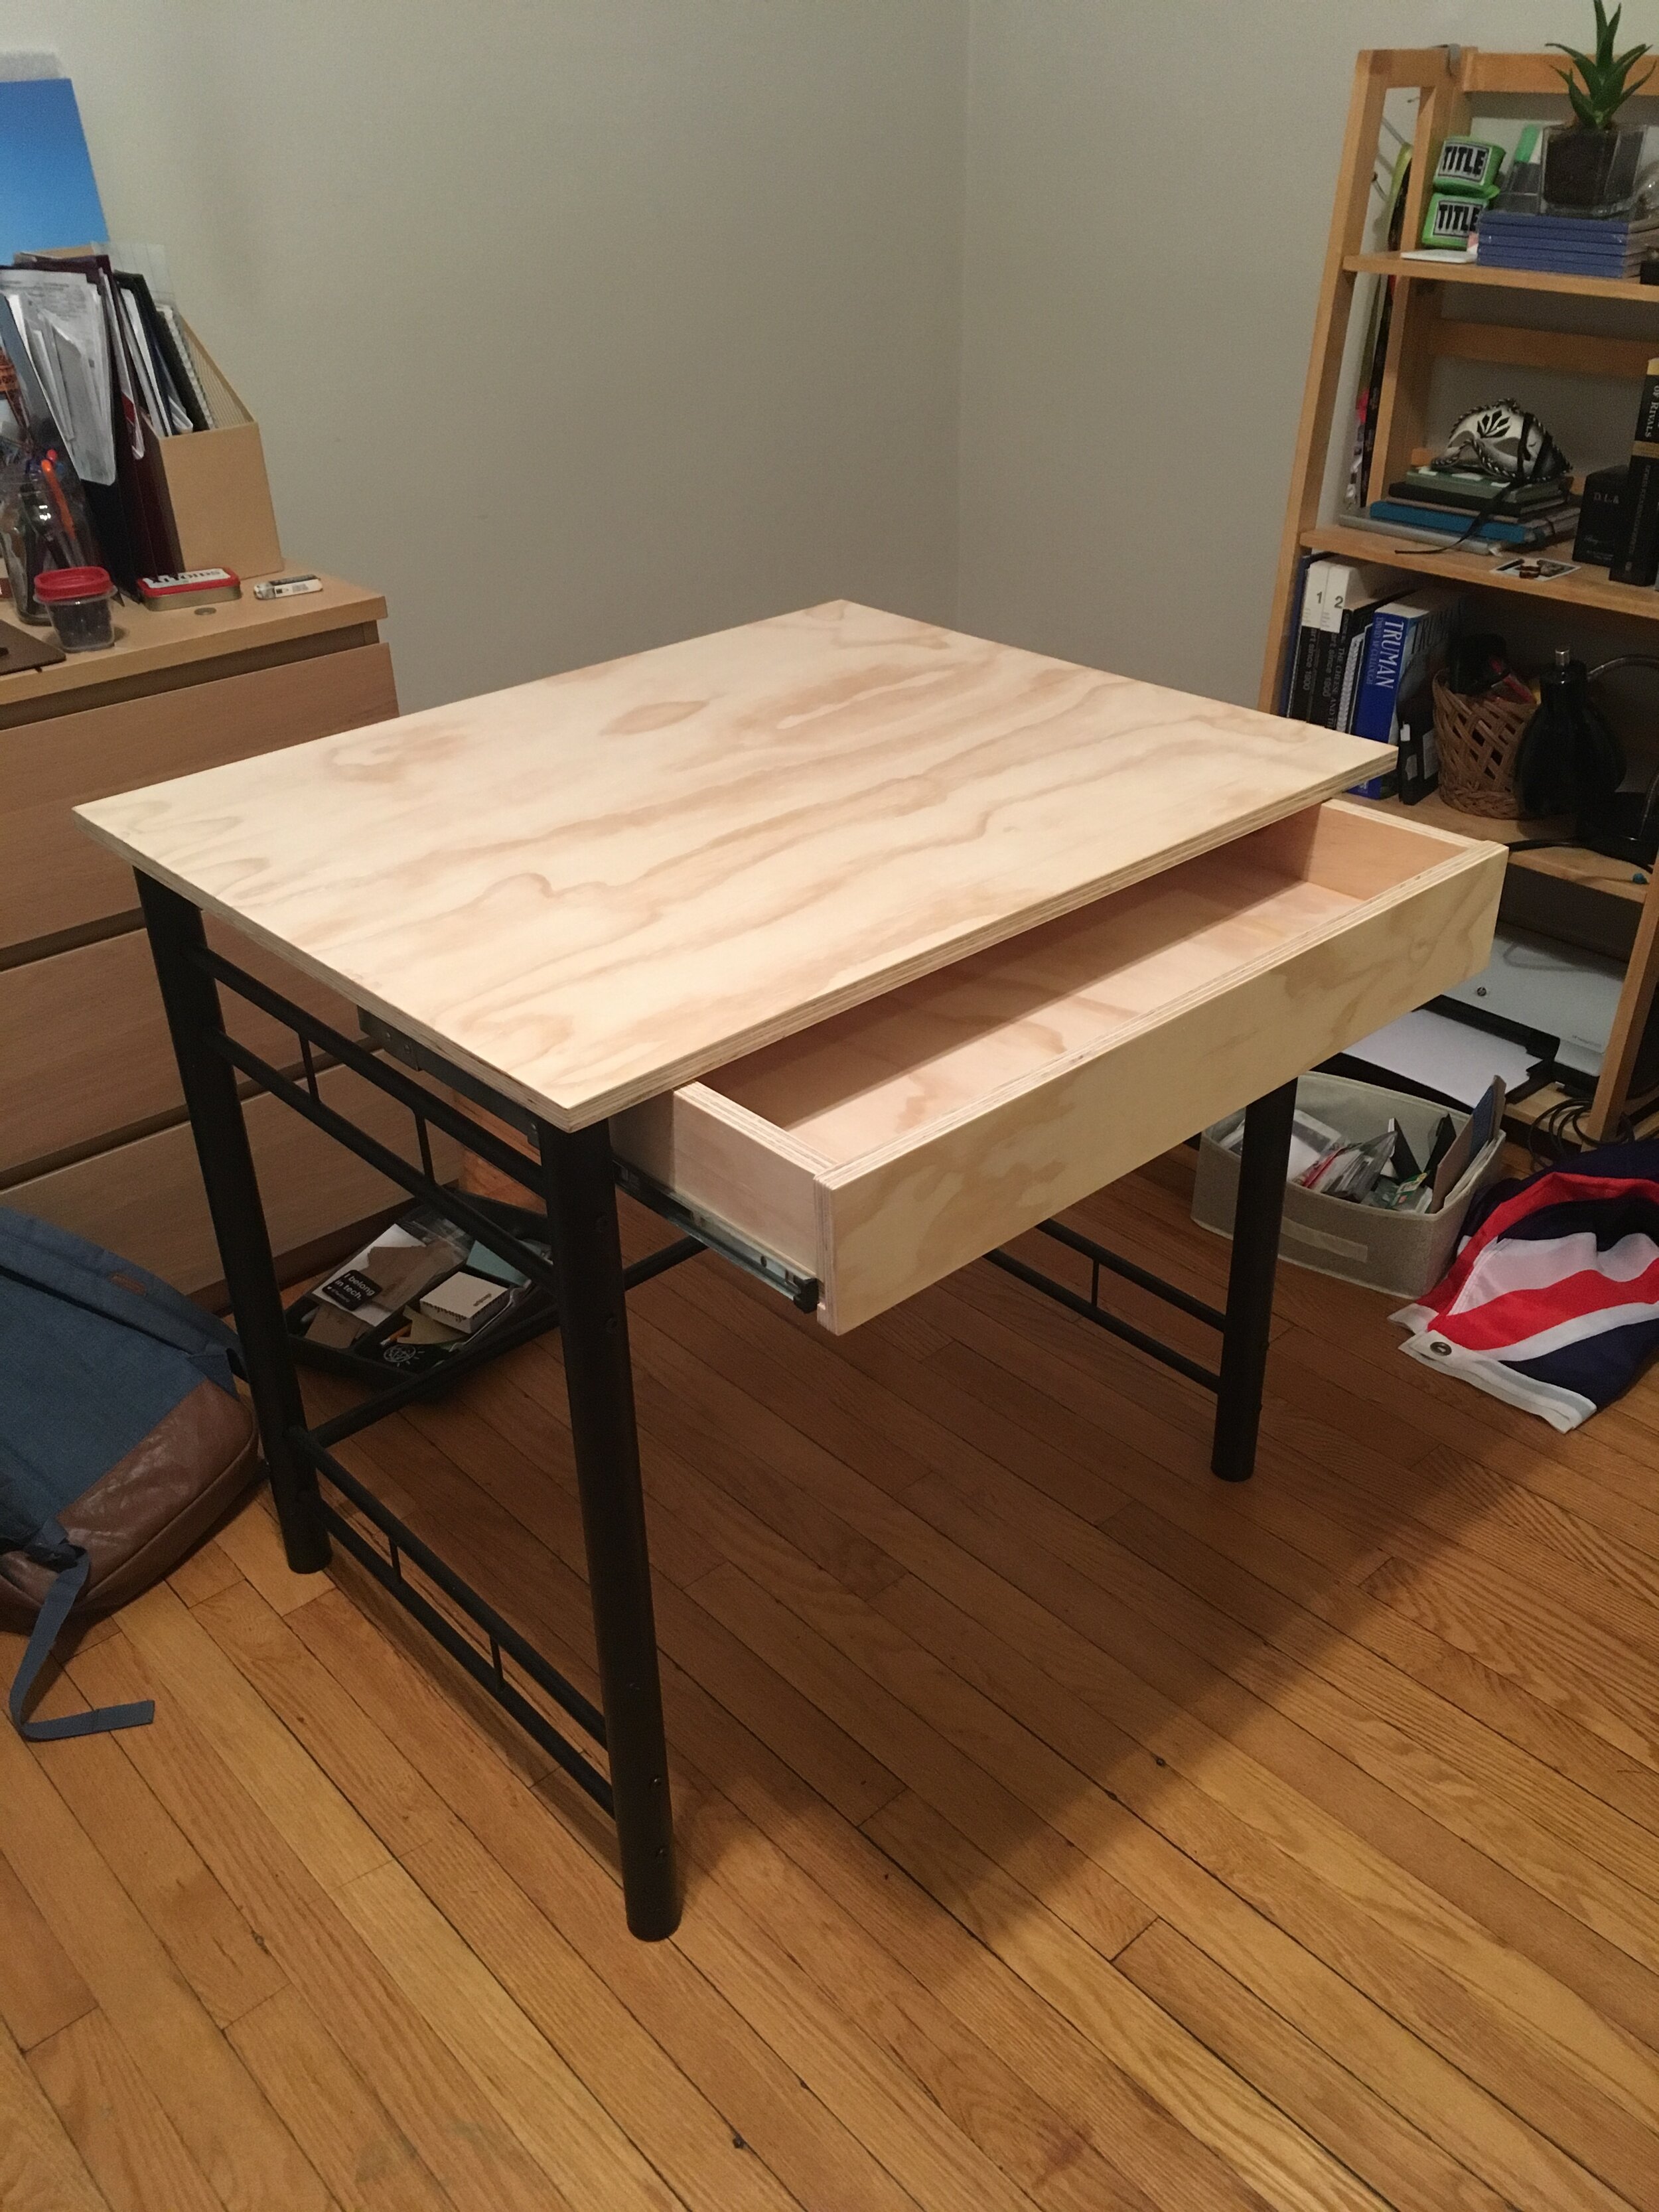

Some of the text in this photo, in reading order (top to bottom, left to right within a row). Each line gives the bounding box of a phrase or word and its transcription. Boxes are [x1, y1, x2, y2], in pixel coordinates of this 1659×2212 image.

[1442, 145, 1486, 175] TITLE
[1438, 204, 1480, 232] TITLE
[1644, 401, 1659, 438] RIVALS
[1316, 591, 1323, 604] 1
[1334, 595, 1343, 609] 2
[1375, 621, 1404, 689] TRUMAN
[343, 1284, 362, 1301] tech.
[348, 1276, 376, 1296] belong
